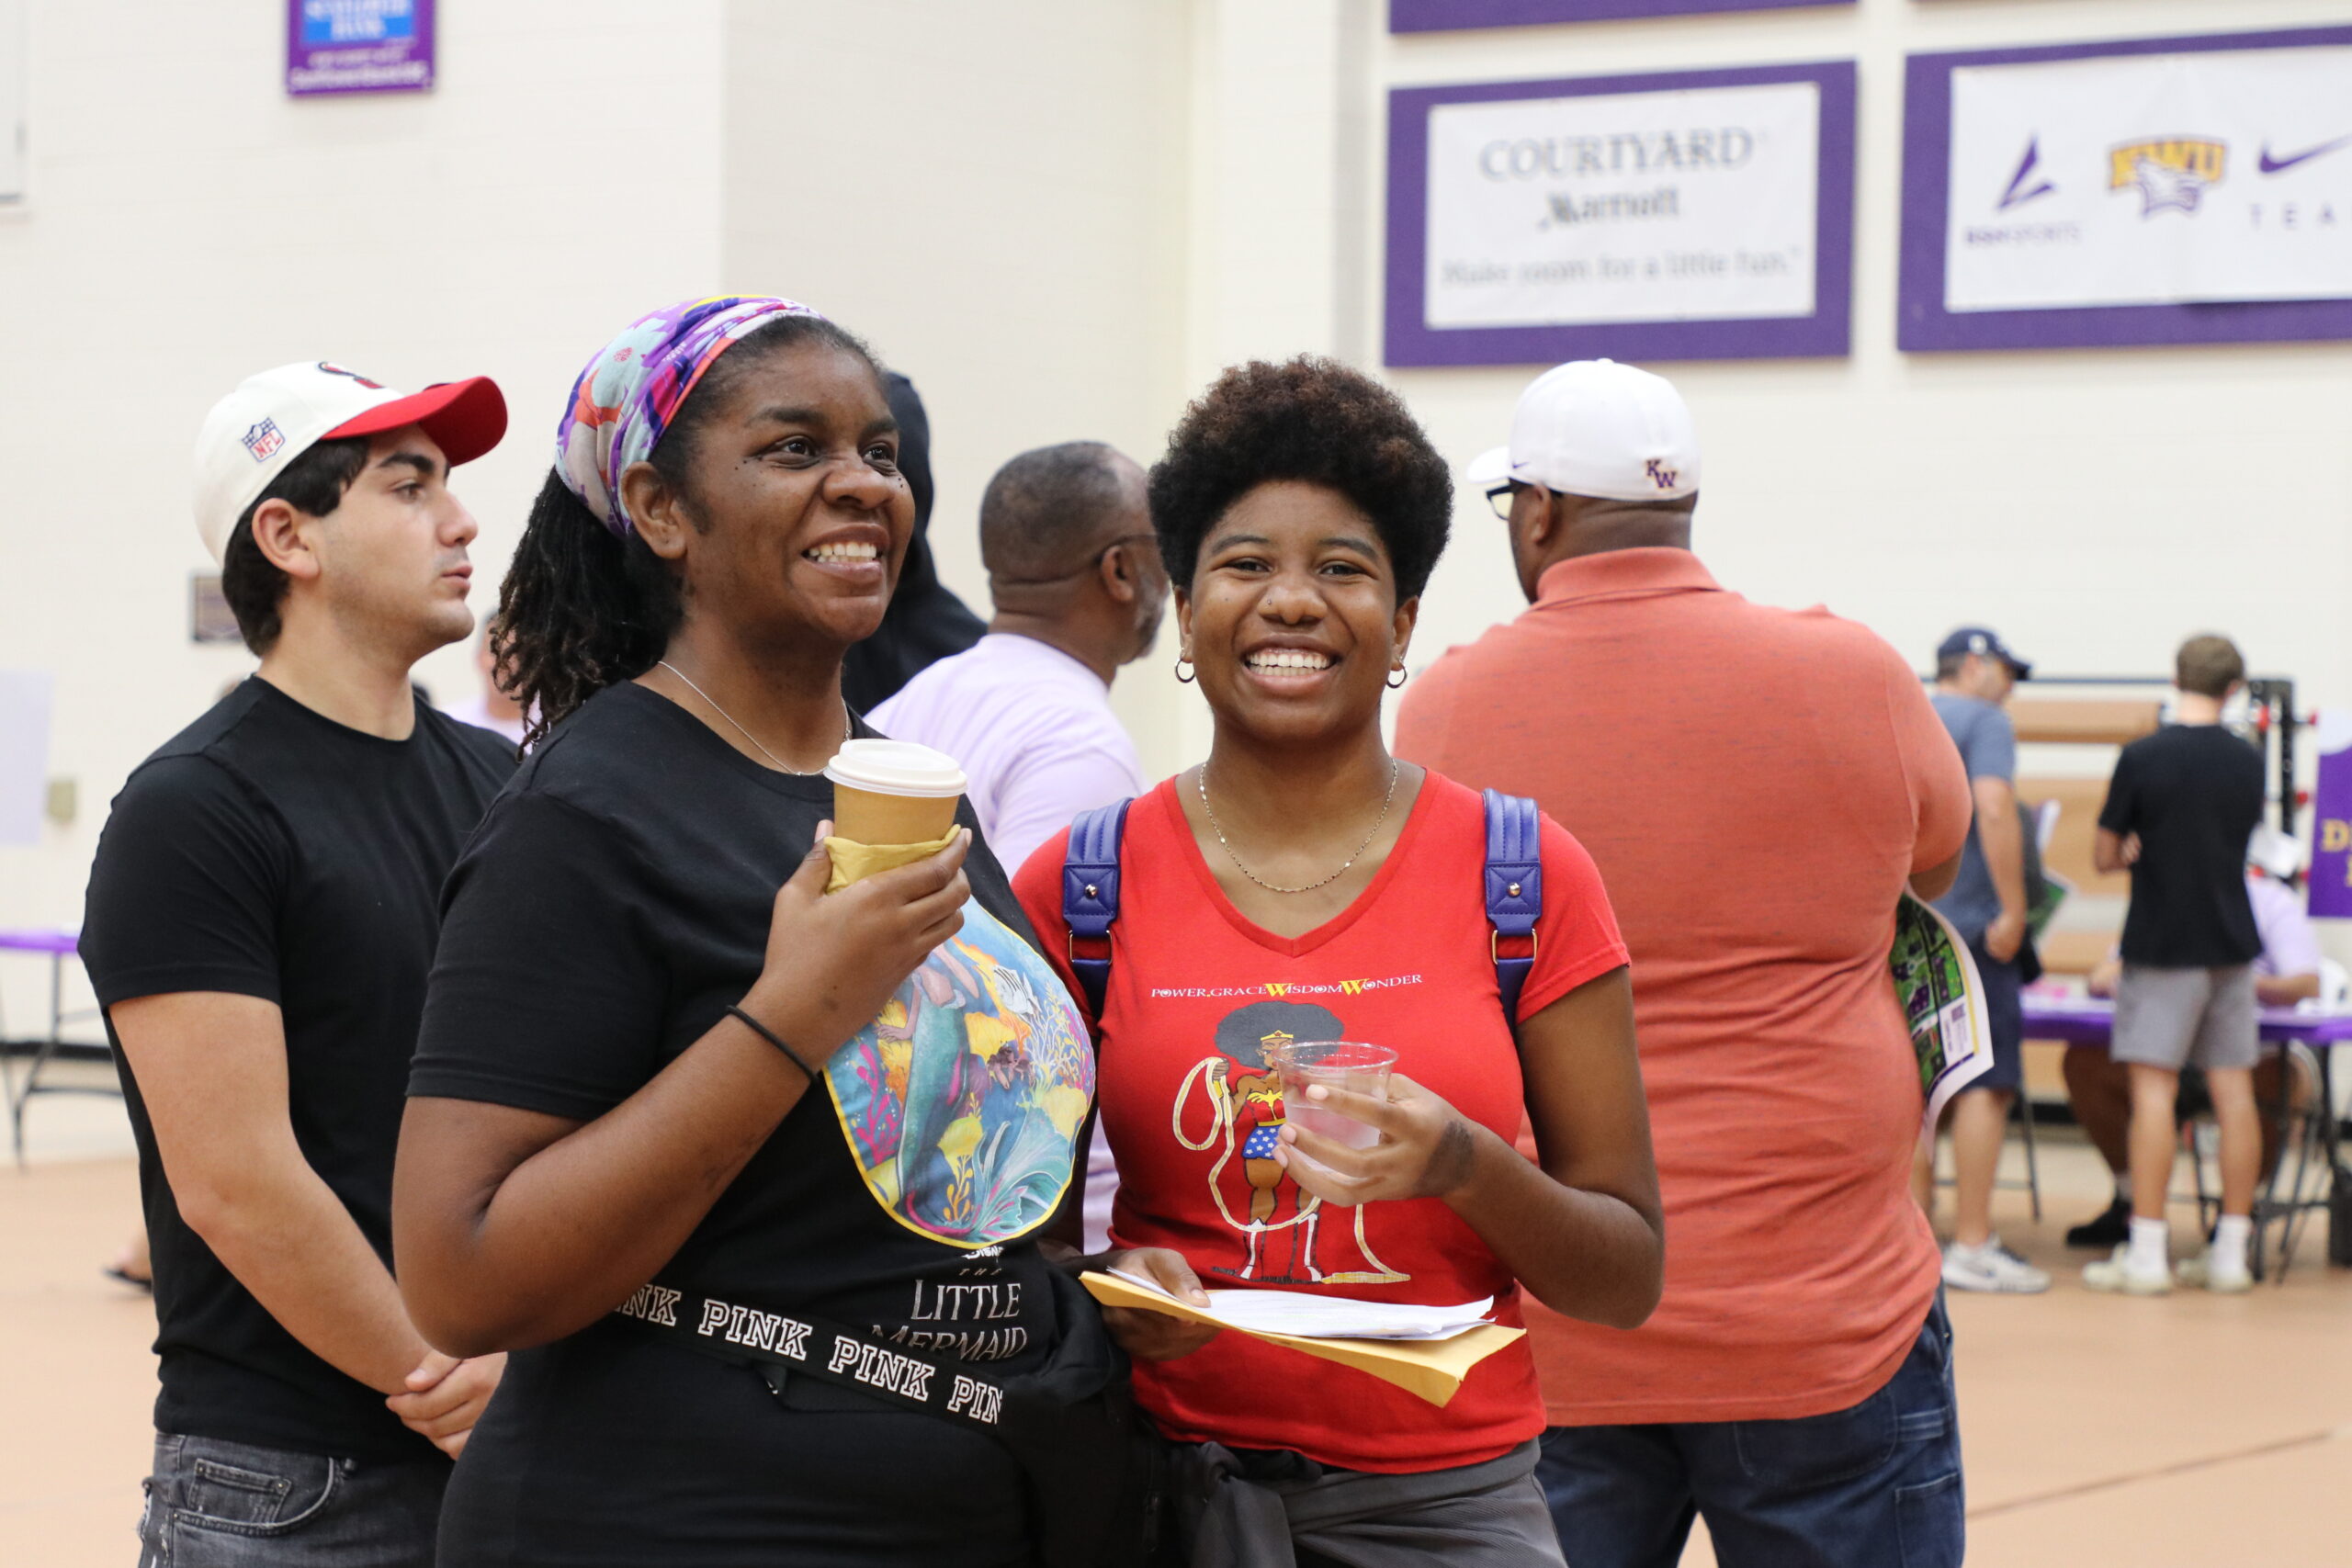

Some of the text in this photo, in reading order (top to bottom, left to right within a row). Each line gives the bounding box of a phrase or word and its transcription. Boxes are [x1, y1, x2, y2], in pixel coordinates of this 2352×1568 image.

[1478, 125, 1755, 182] COURTYARD
[252, 432, 282, 459] NFL
[910, 1279, 1022, 1321] LITTLE
[697, 1298, 813, 1360] PINK
[827, 1335, 935, 1402] PINK
